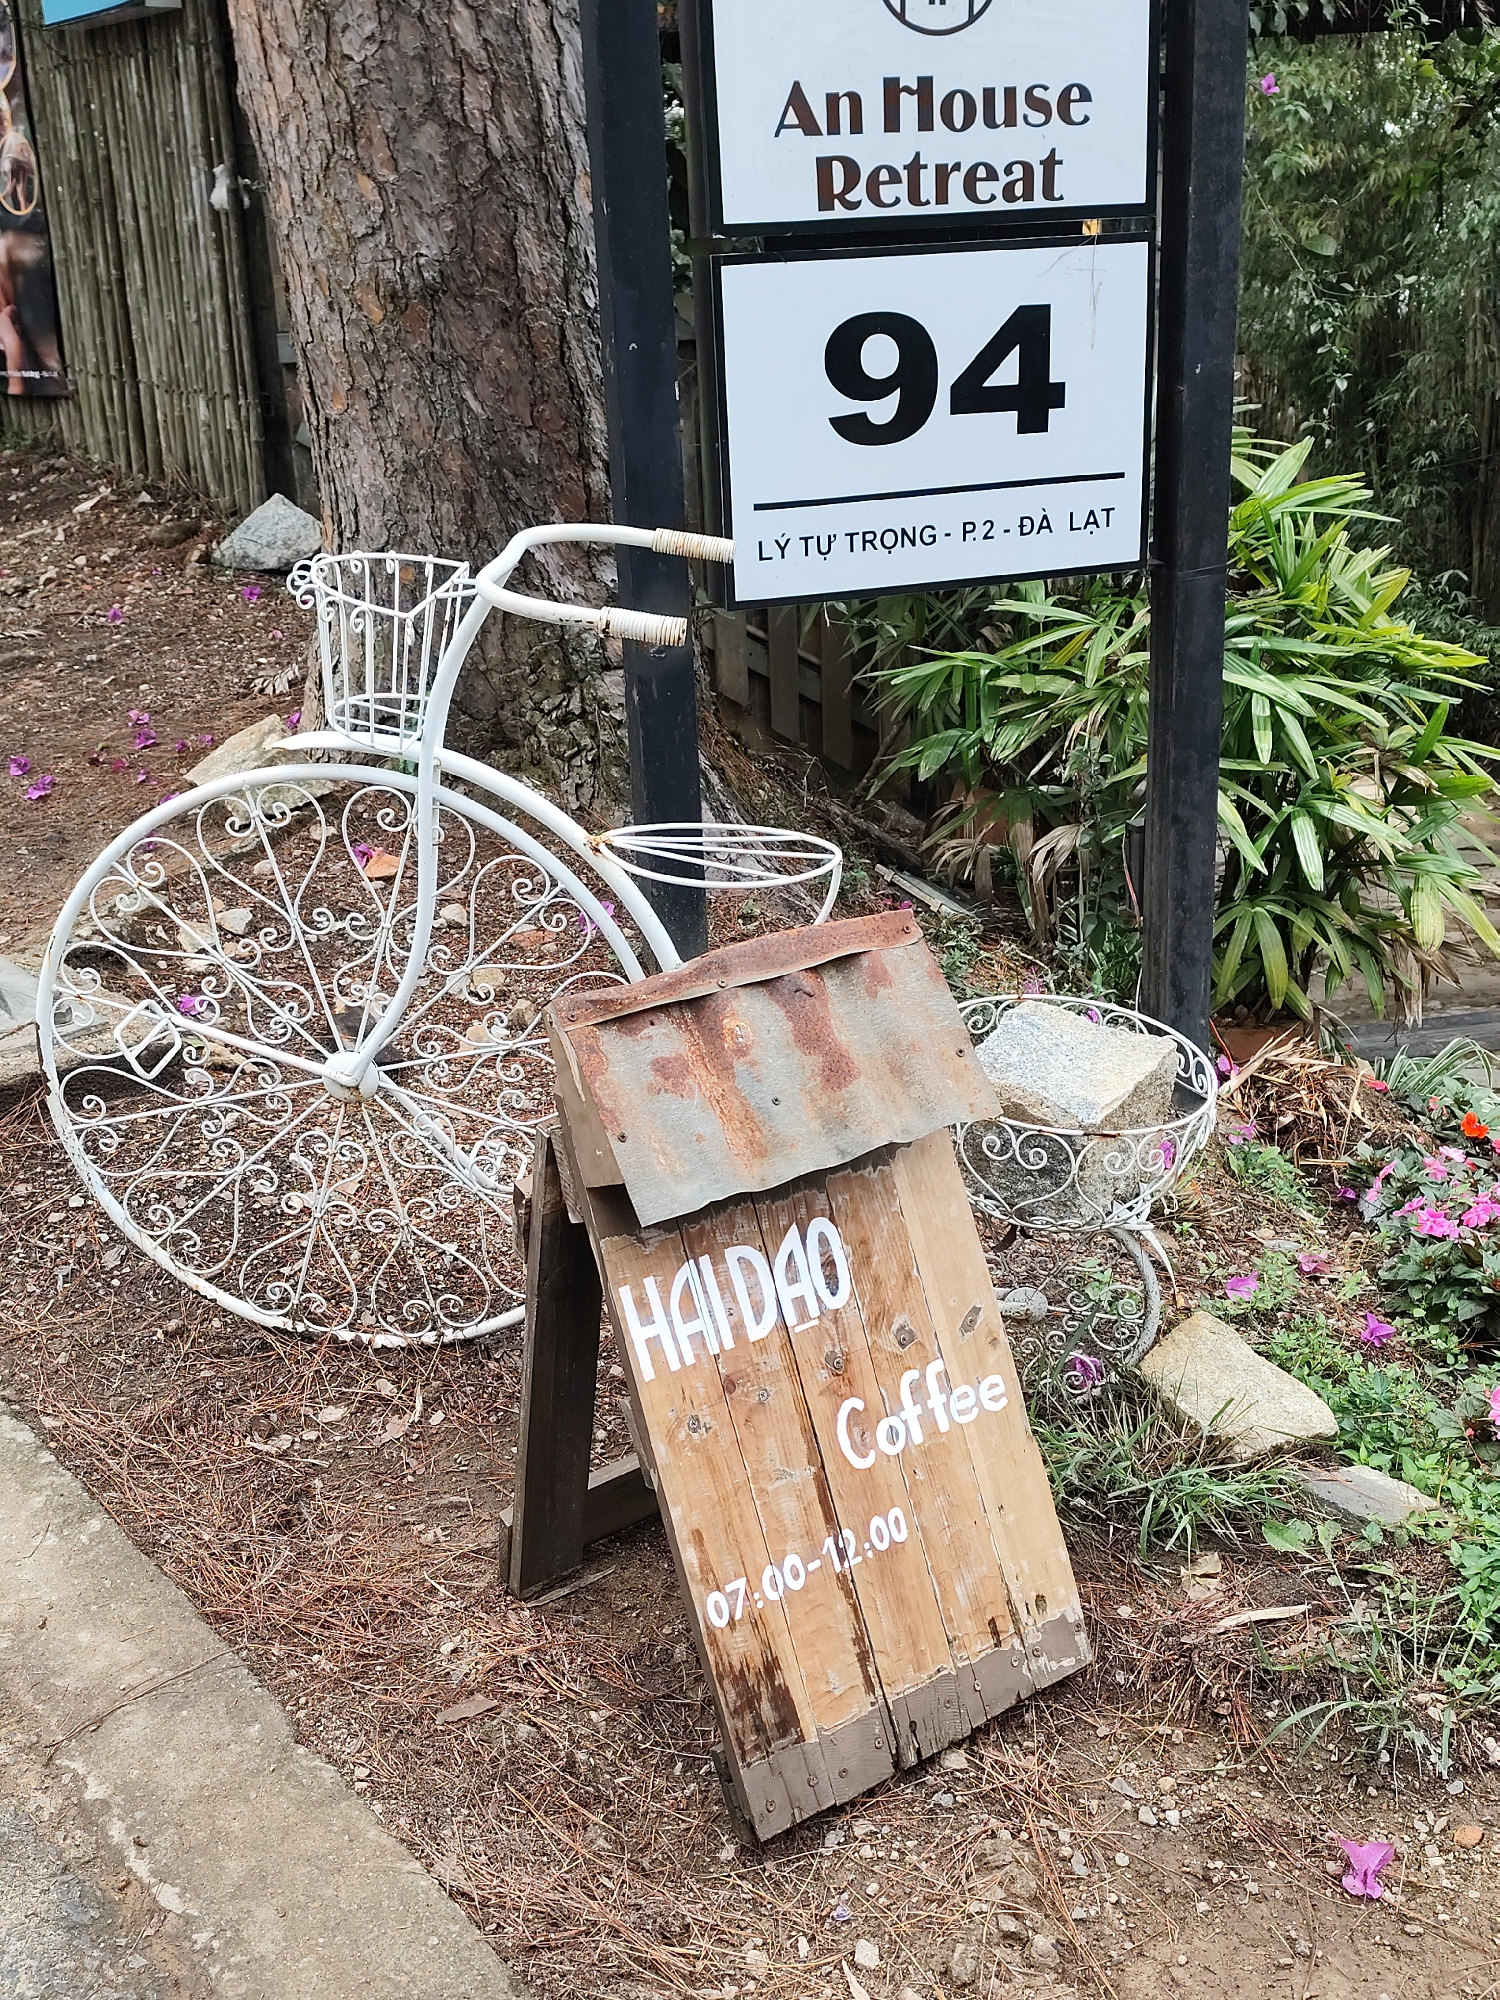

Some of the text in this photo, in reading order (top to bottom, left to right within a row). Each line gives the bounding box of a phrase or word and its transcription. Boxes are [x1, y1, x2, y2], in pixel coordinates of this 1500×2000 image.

[774, 75, 1093, 138] An House
[816, 147, 1064, 212] Retreat
[824, 303, 1066, 447] 94
[758, 532, 791, 562] LÝ
[799, 533, 837, 562] TỰ
[845, 525, 937, 555] TRỌNG
[1017, 507, 1054, 537] ĐÀ
[1069, 507, 1116, 536] LẠT
[837, 1358, 1009, 1470] Coffee
[706, 1506, 909, 1628] 07:00-12:00
